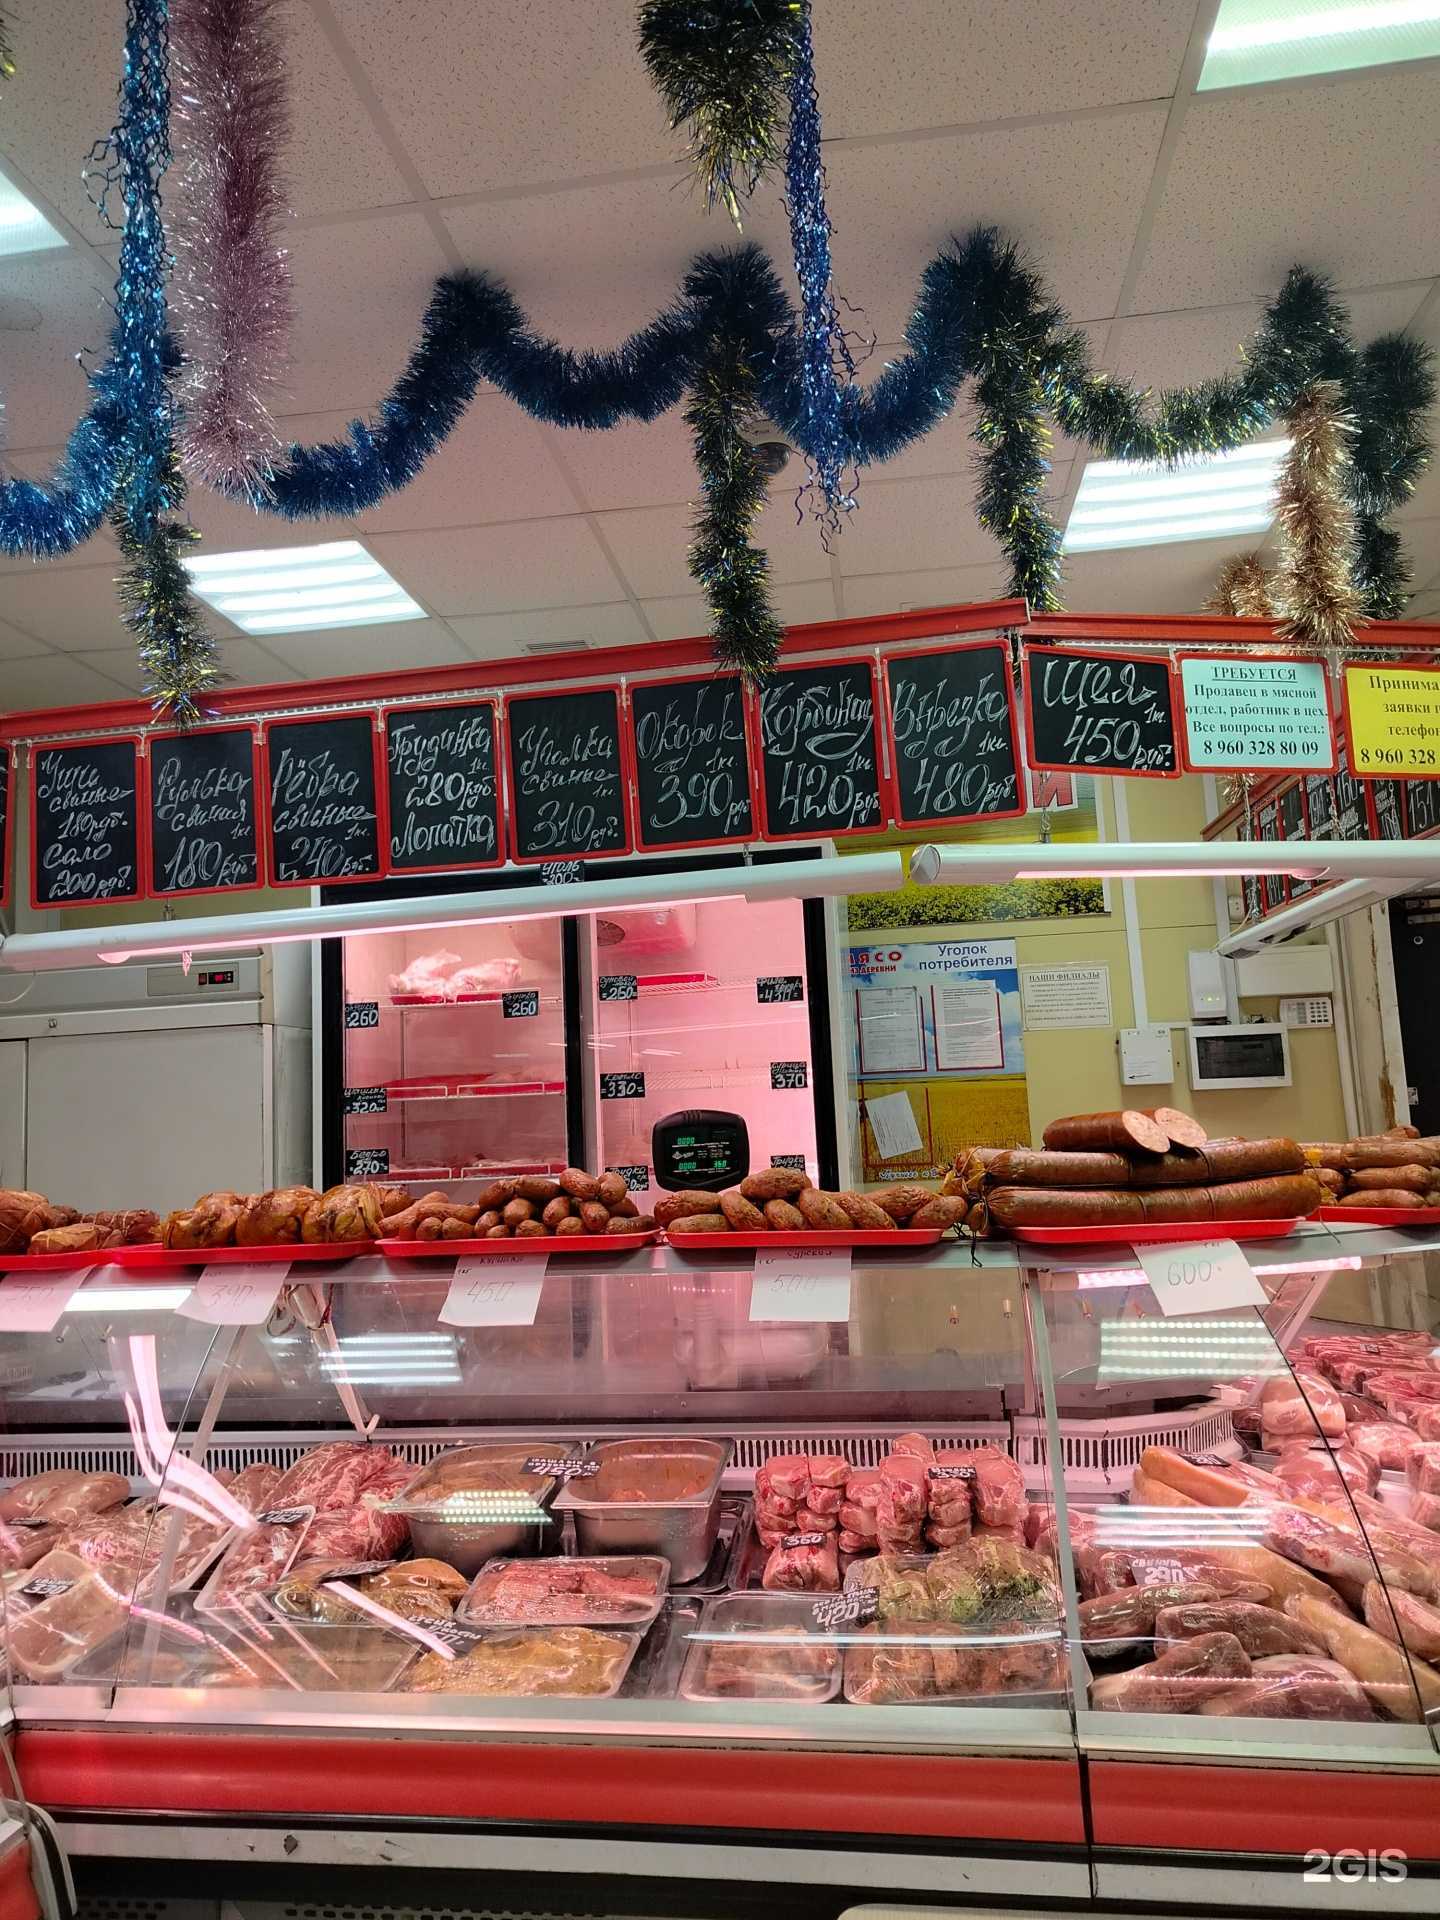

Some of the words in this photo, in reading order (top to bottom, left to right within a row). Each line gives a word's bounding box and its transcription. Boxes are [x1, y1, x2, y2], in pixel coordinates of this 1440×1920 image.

[1211, 667, 1297, 680] ТРЕБУЕТСЯ
[1194, 684, 1257, 699] Продавец
[1261, 690, 1269, 698] в
[1272, 687, 1317, 699] мясной
[1185, 704, 1227, 716] отдел,
[1230, 703, 1290, 717] работник
[1294, 708, 1301, 716] в
[1304, 708, 1329, 718] цех.
[1384, 703, 1430, 714] заявки
[1193, 720, 1216, 733] Все
[1220, 722, 1275, 736] вопросы
[1279, 724, 1294, 734] по
[387, 716, 491, 776] Грудинка
[1063, 714, 1141, 763] 450
[1203, 741, 1213, 755] 8
[1217, 740, 1244, 755] 960
[1248, 740, 1275, 755] 328
[1280, 741, 1297, 755] 80
[1301, 741, 1319, 755] 09
[1360, 748, 1370, 763] 8
[1375, 748, 1403, 763] 960
[1408, 749, 1436, 764] 328
[914, 757, 990, 815] 480
[391, 812, 495, 858] Лопатка
[43, 843, 112, 869] Сало
[163, 836, 221, 892] 180
[938, 945, 987, 957] Уголок
[919, 956, 1013, 972] потребителя
